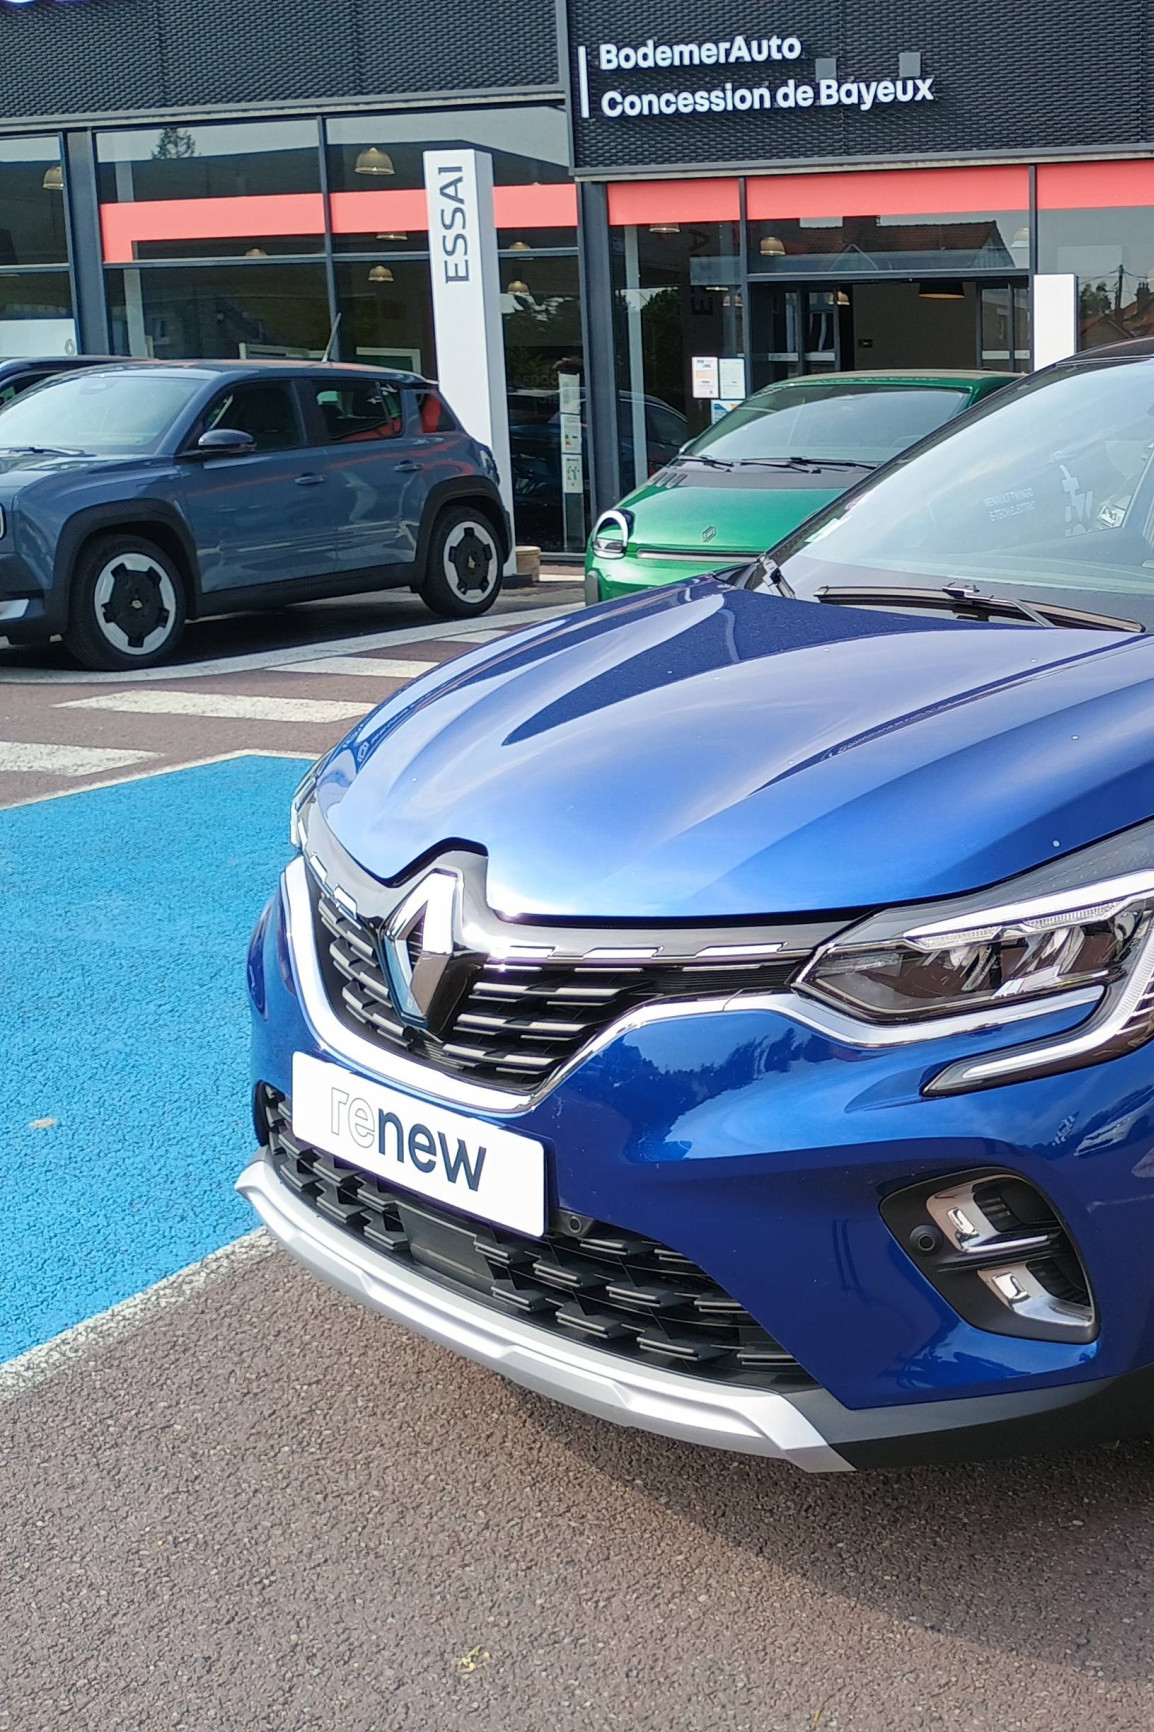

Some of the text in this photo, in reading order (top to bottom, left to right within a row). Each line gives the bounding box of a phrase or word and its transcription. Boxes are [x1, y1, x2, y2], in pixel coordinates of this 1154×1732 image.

[600, 35, 802, 70] BodemerAuto
[601, 77, 935, 117] Concession de Bayeux
[438, 166, 470, 284] ESSAI
[331, 1086, 488, 1192] renew
